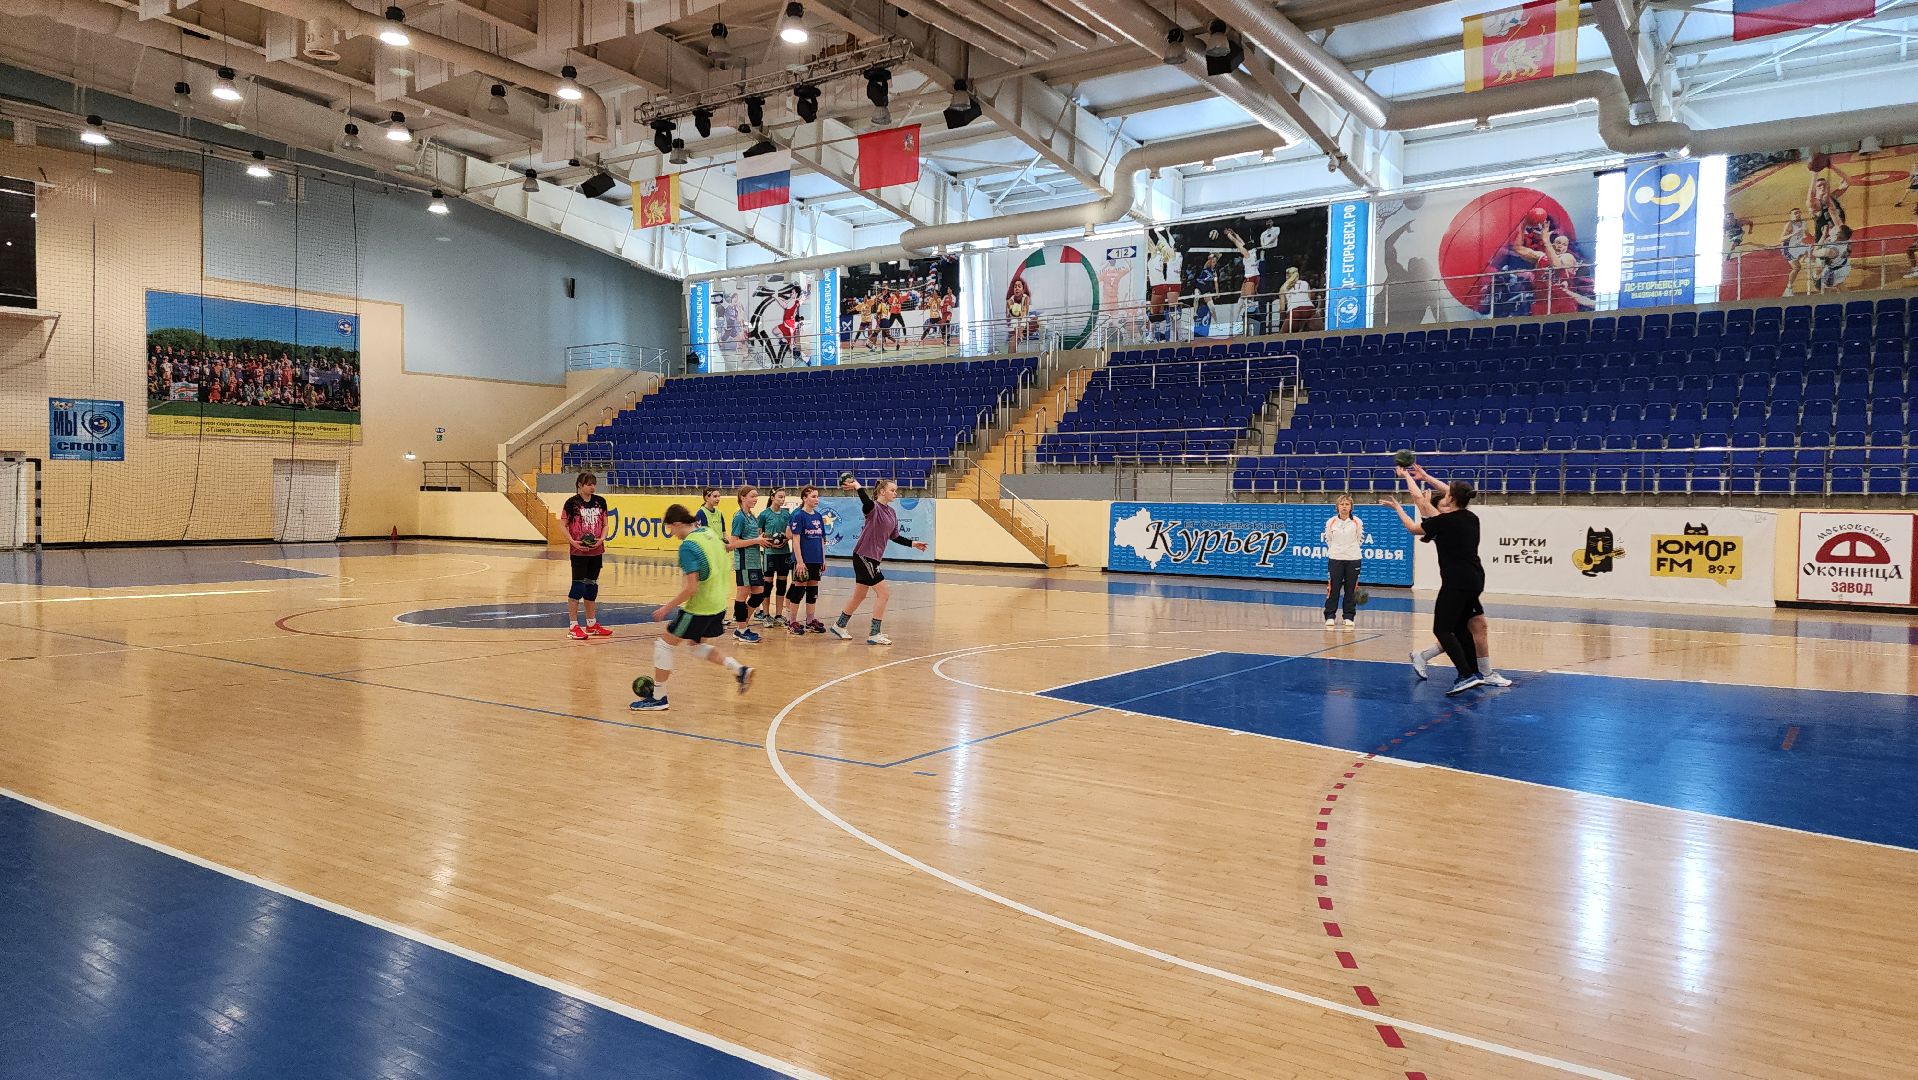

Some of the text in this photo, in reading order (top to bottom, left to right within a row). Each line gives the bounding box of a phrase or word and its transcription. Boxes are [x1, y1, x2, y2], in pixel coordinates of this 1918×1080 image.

[53, 410, 78, 437] МЫ
[1145, 520, 1288, 567] Курьер
[1499, 537, 1547, 547] ШУТКИ
[1656, 539, 1737, 562] ЮМОР
[1504, 554, 1553, 565] ПЕ-СНИ
[1656, 557, 1737, 575] FM 89.7
